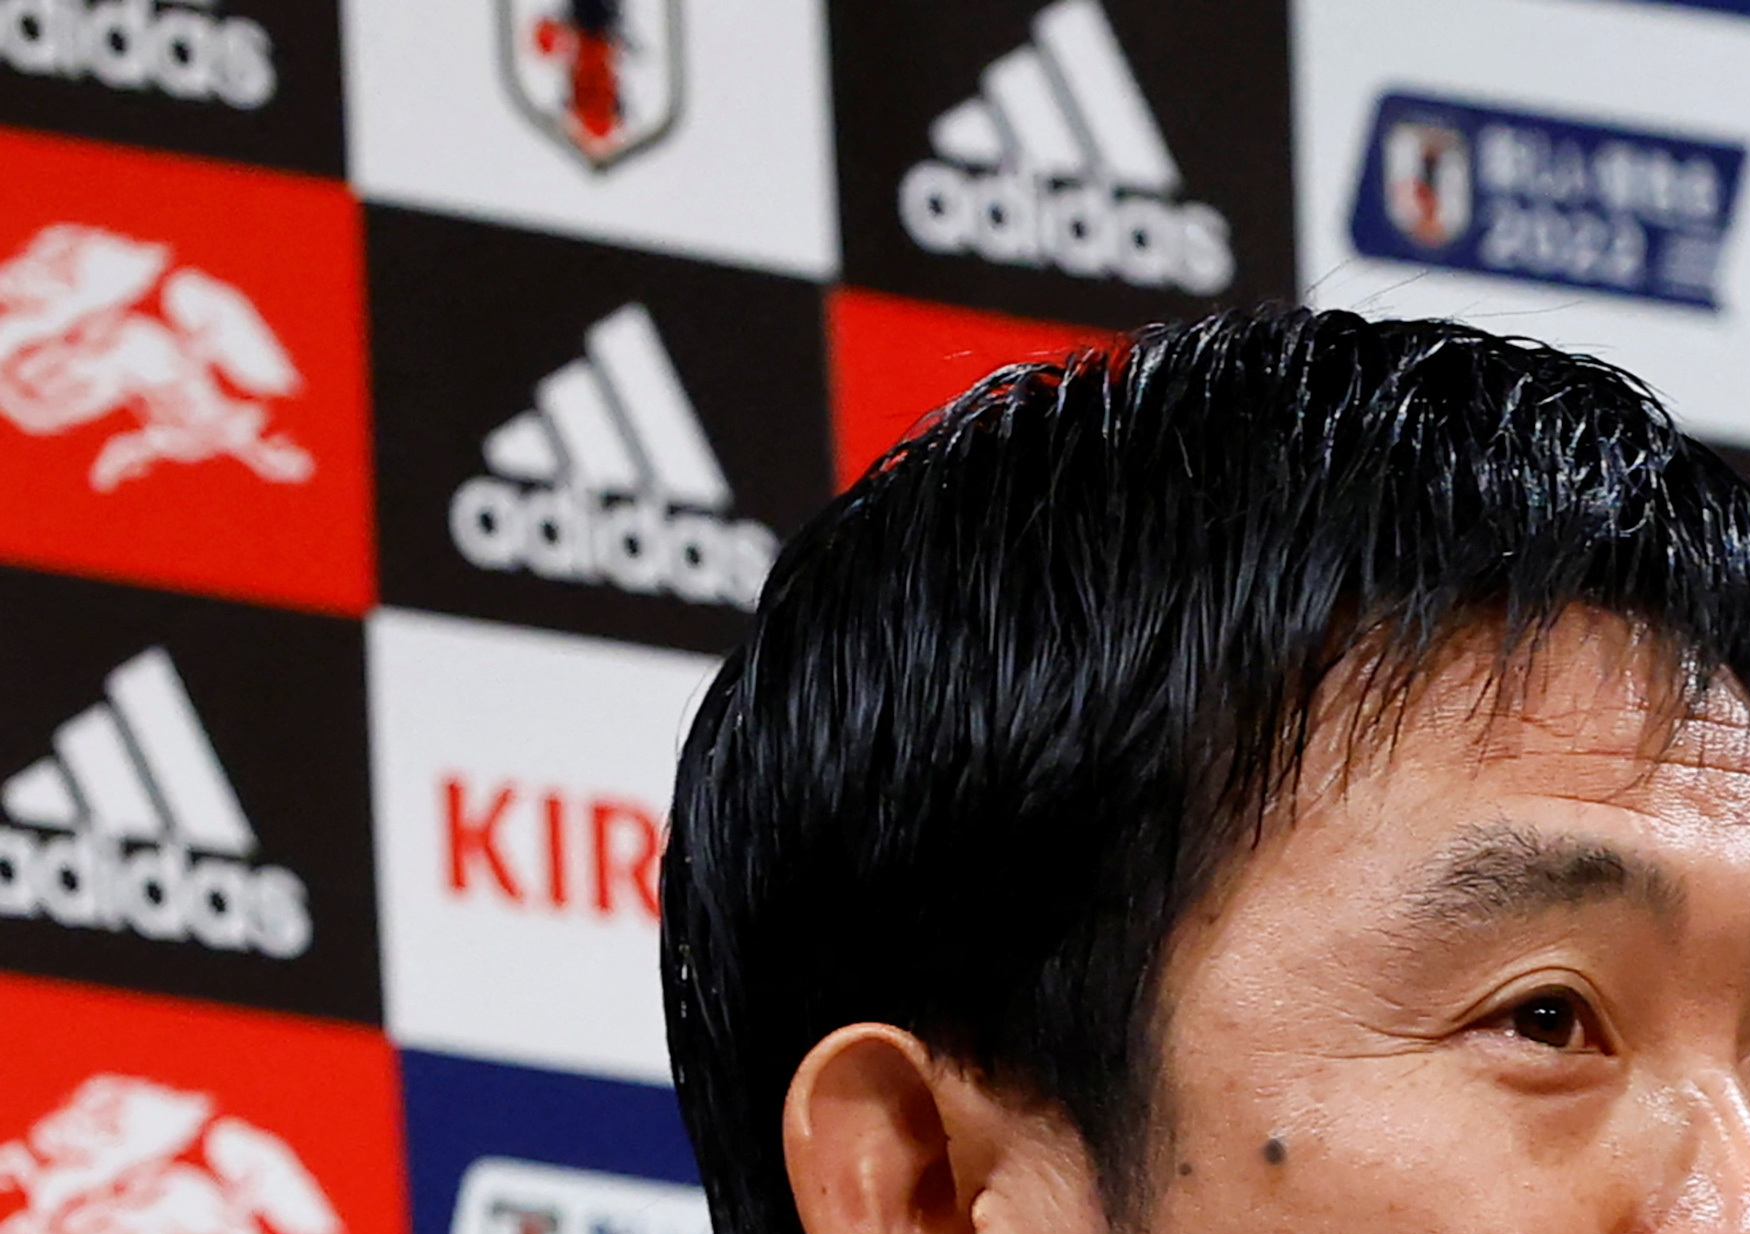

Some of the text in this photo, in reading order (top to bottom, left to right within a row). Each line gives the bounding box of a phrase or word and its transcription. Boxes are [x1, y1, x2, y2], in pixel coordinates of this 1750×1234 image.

[0, 0, 273, 108] didas
[897, 160, 1233, 294] adidas
[449, 475, 782, 610] adidas
